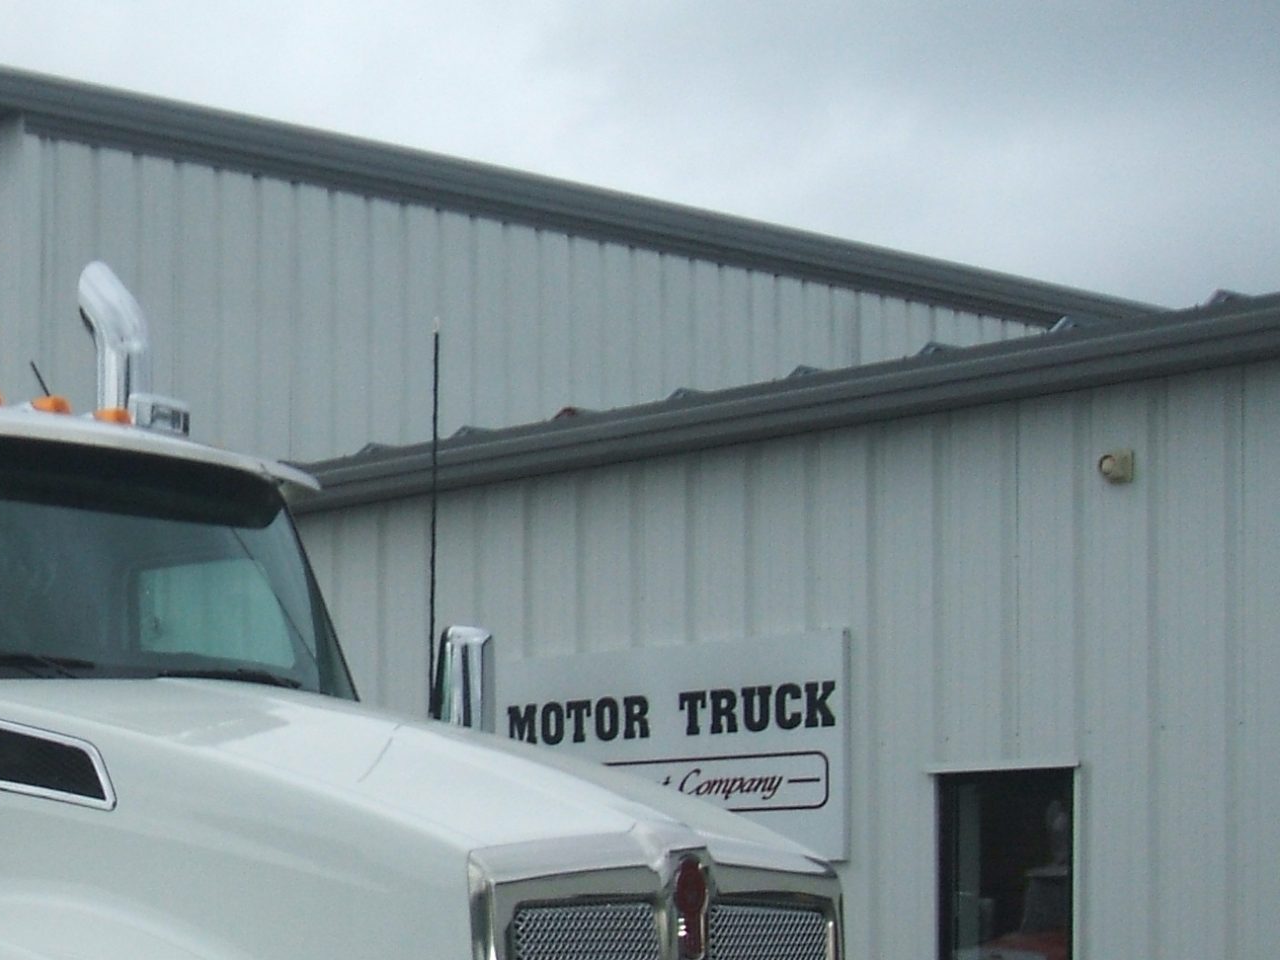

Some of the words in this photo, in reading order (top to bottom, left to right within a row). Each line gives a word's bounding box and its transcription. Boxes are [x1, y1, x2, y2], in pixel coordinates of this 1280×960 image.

[507, 695, 650, 746] MOTOR
[678, 680, 836, 736] TRUCK
[678, 768, 783, 800] Company
